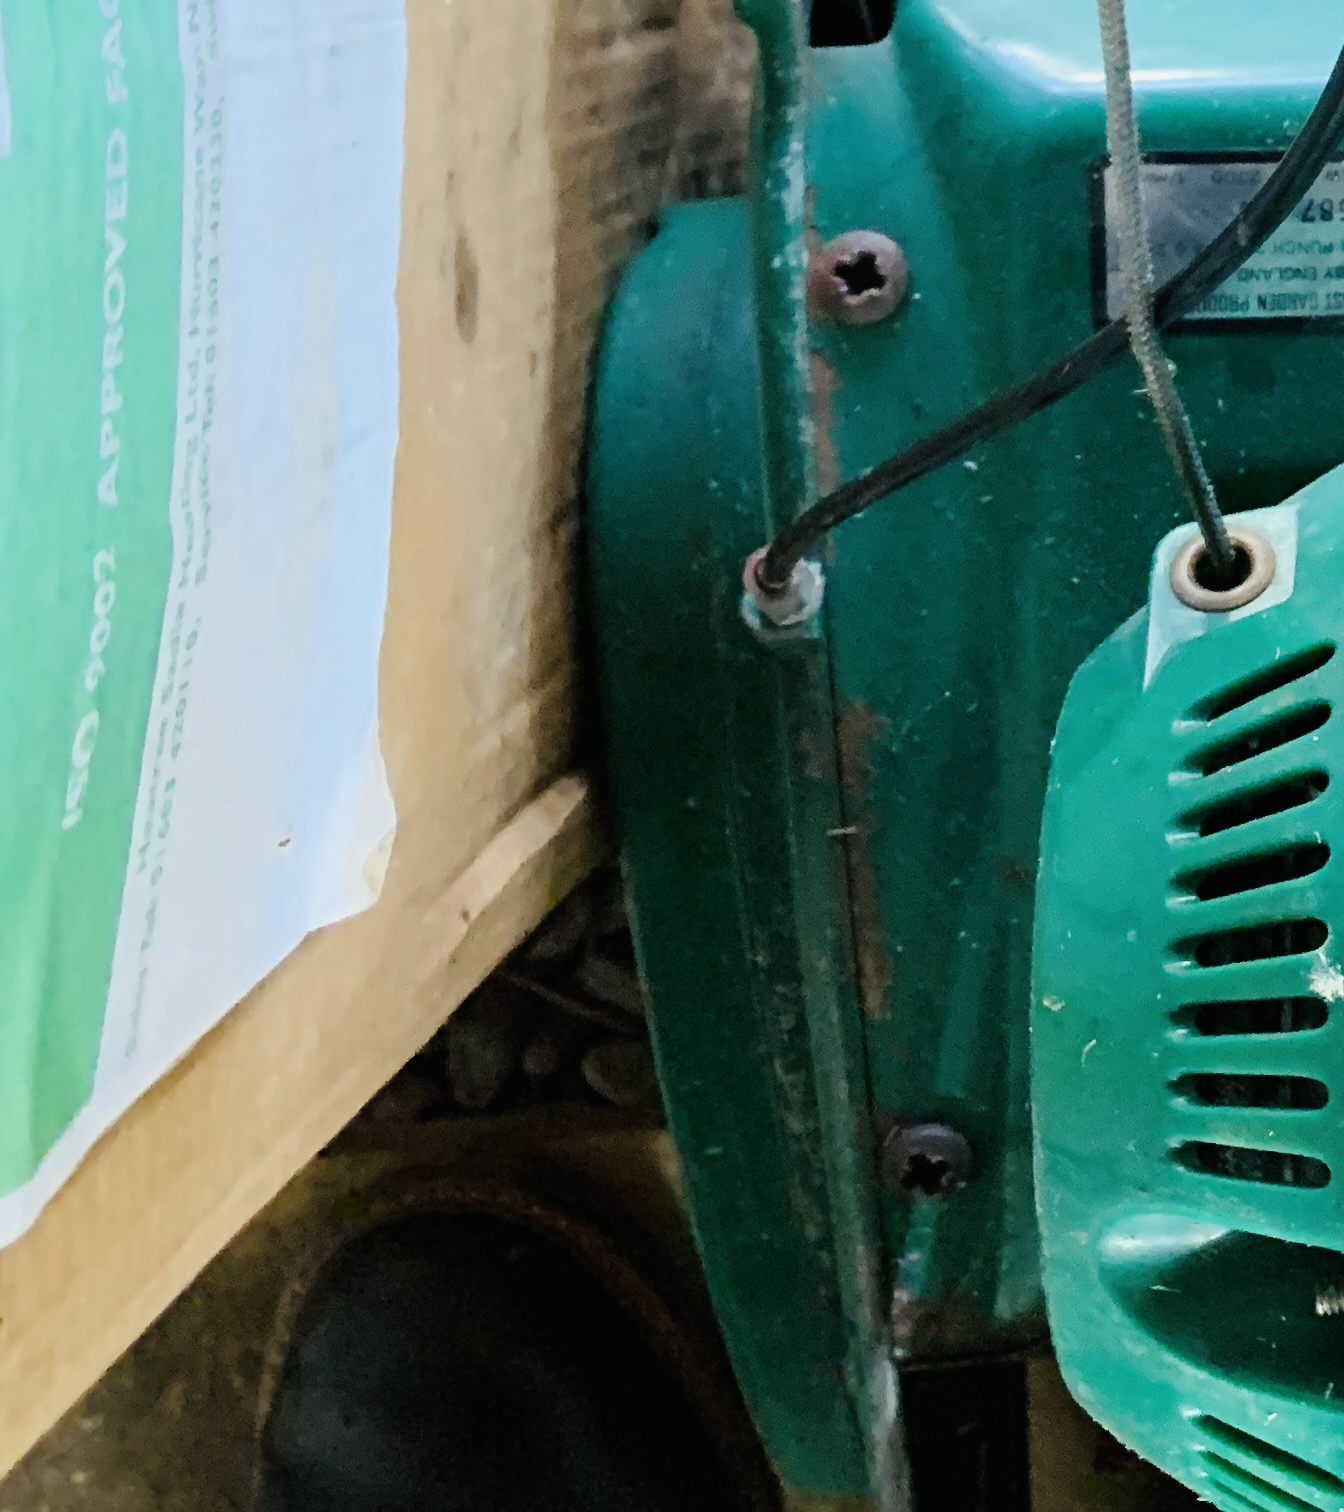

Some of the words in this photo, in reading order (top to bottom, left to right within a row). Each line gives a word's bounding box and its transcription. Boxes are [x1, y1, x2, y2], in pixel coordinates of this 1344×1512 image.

[97, 127, 128, 507] APPROVED
[1234, 267, 1318, 284] ENGLAND
[1257, 291, 1319, 312] GARDEN
[83, 544, 117, 694] 9002
[60, 707, 100, 832] ISO
